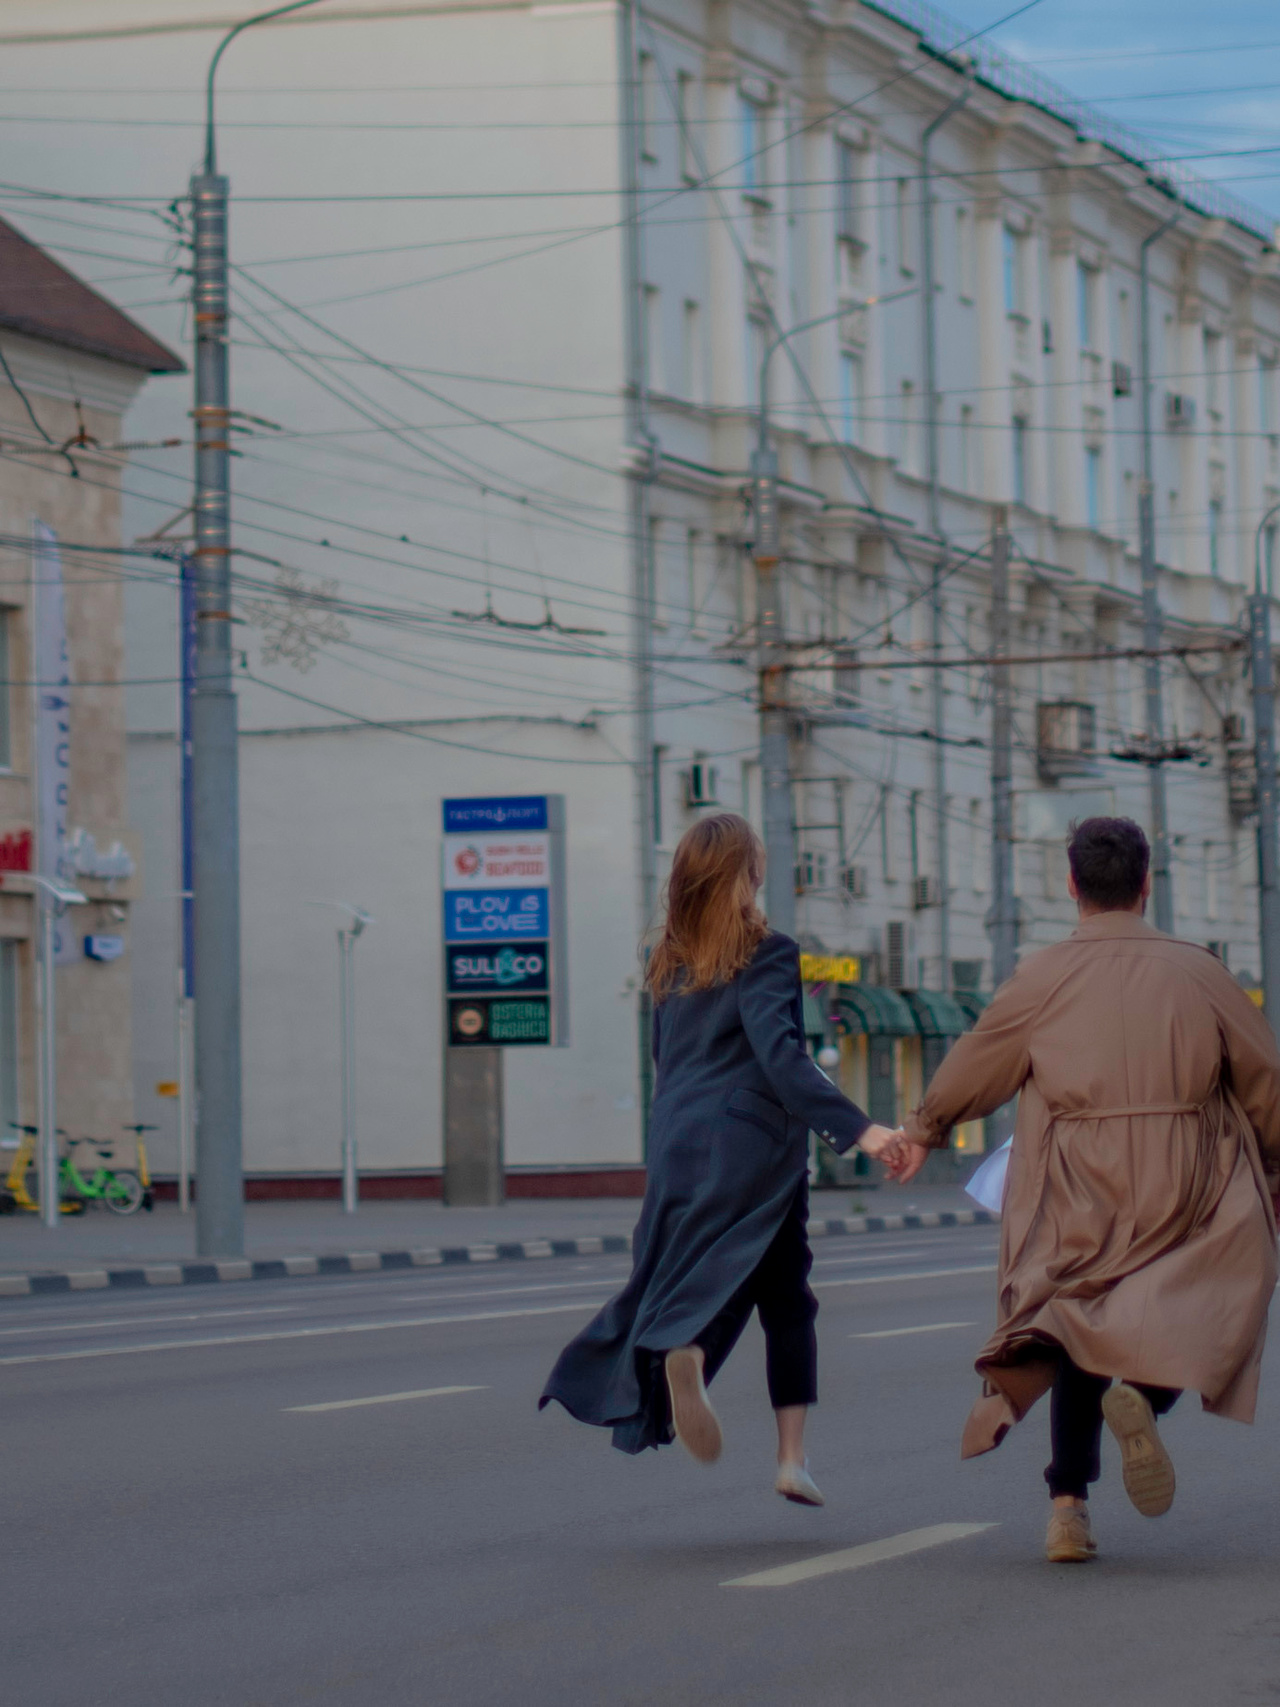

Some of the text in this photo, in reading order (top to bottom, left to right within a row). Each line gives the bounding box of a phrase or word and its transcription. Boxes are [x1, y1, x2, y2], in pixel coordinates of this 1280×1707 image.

[455, 895, 540, 914] PLOV IS
[455, 913, 540, 932] LOVE
[492, 1003, 546, 1020] OSTERIA
